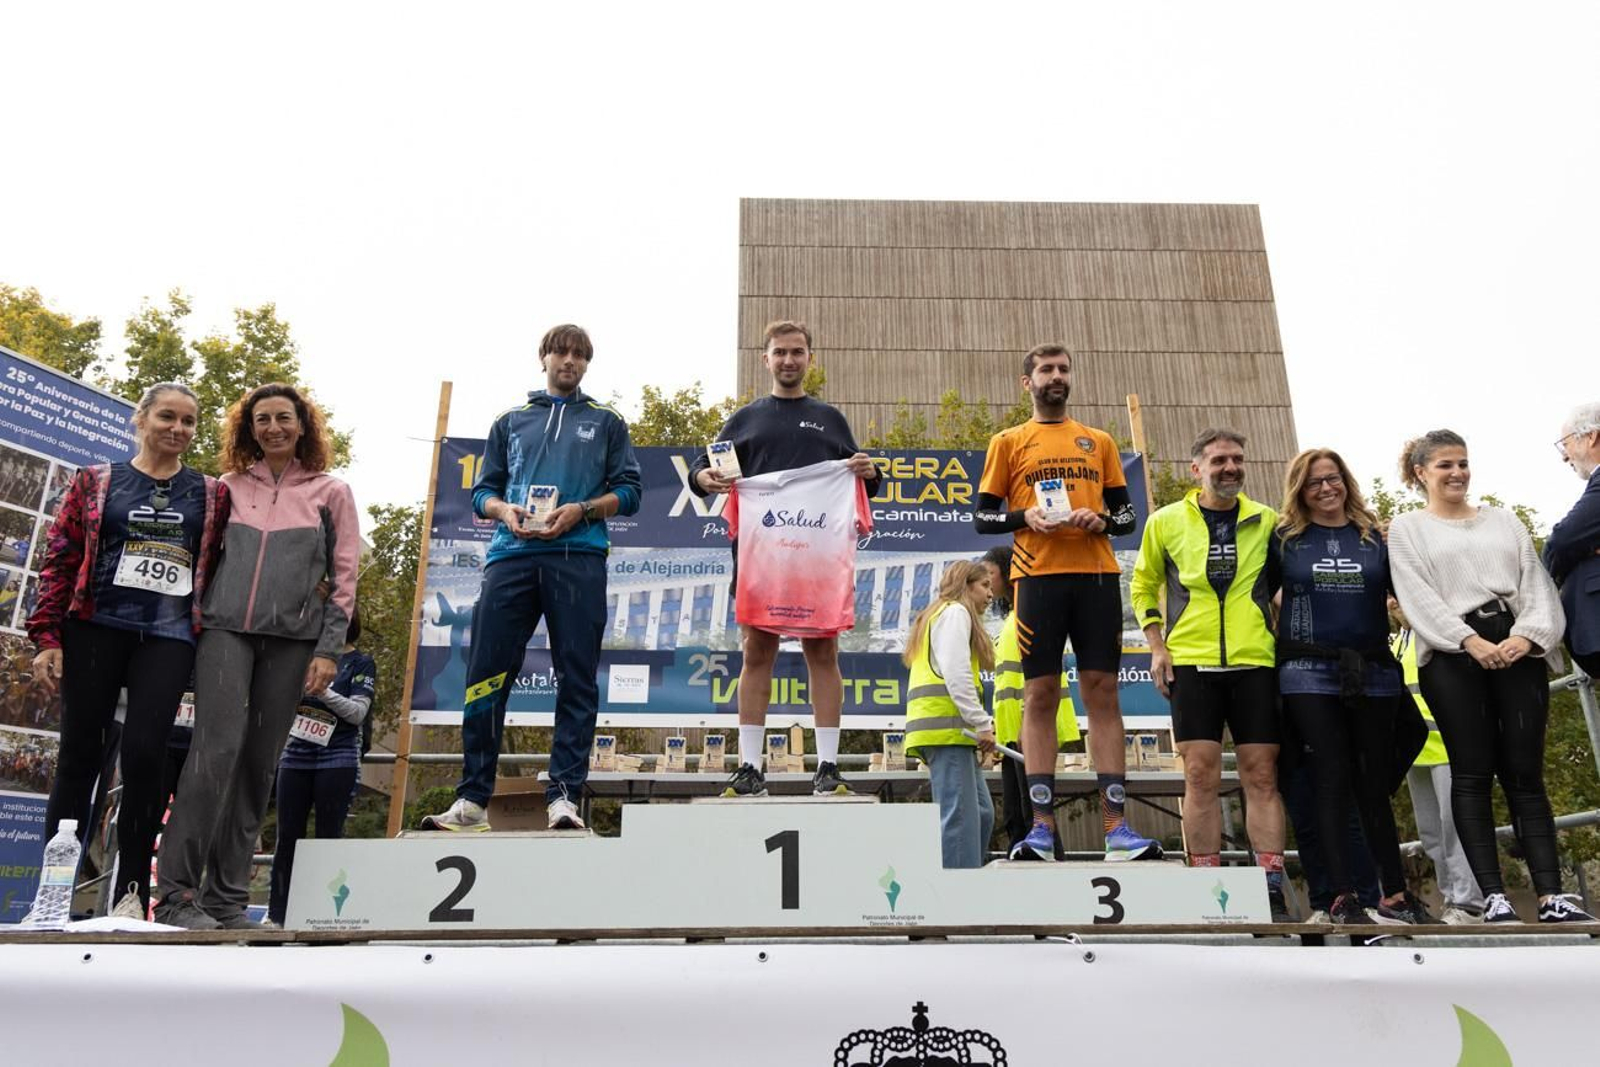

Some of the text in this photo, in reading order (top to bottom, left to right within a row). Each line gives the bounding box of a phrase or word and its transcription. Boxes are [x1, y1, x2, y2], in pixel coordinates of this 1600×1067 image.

[17, 388, 64, 412] Popular
[63, 408, 72, 418] y
[72, 410, 99, 428] Gran
[35, 381, 101, 415] Aniversario
[101, 406, 115, 420] de
[115, 413, 126, 425] la
[11, 400, 23, 412] la
[24, 405, 46, 421] Paz
[46, 415, 55, 425] y
[55, 418, 66, 429] la
[67, 421, 129, 452] Integración
[58, 441, 92, 458] deporte,
[1025, 466, 1100, 487] QUEBRAJANO
[774, 509, 827, 529] Salud
[872, 508, 973, 522] caminata
[134, 560, 180, 584] 496
[452, 554, 726, 578] IES de Alejandría
[1312, 558, 1363, 573] 25
[297, 718, 329, 737] 1106
[765, 830, 799, 909] 1
[428, 855, 476, 922] 2
[1090, 876, 1125, 924] 3
